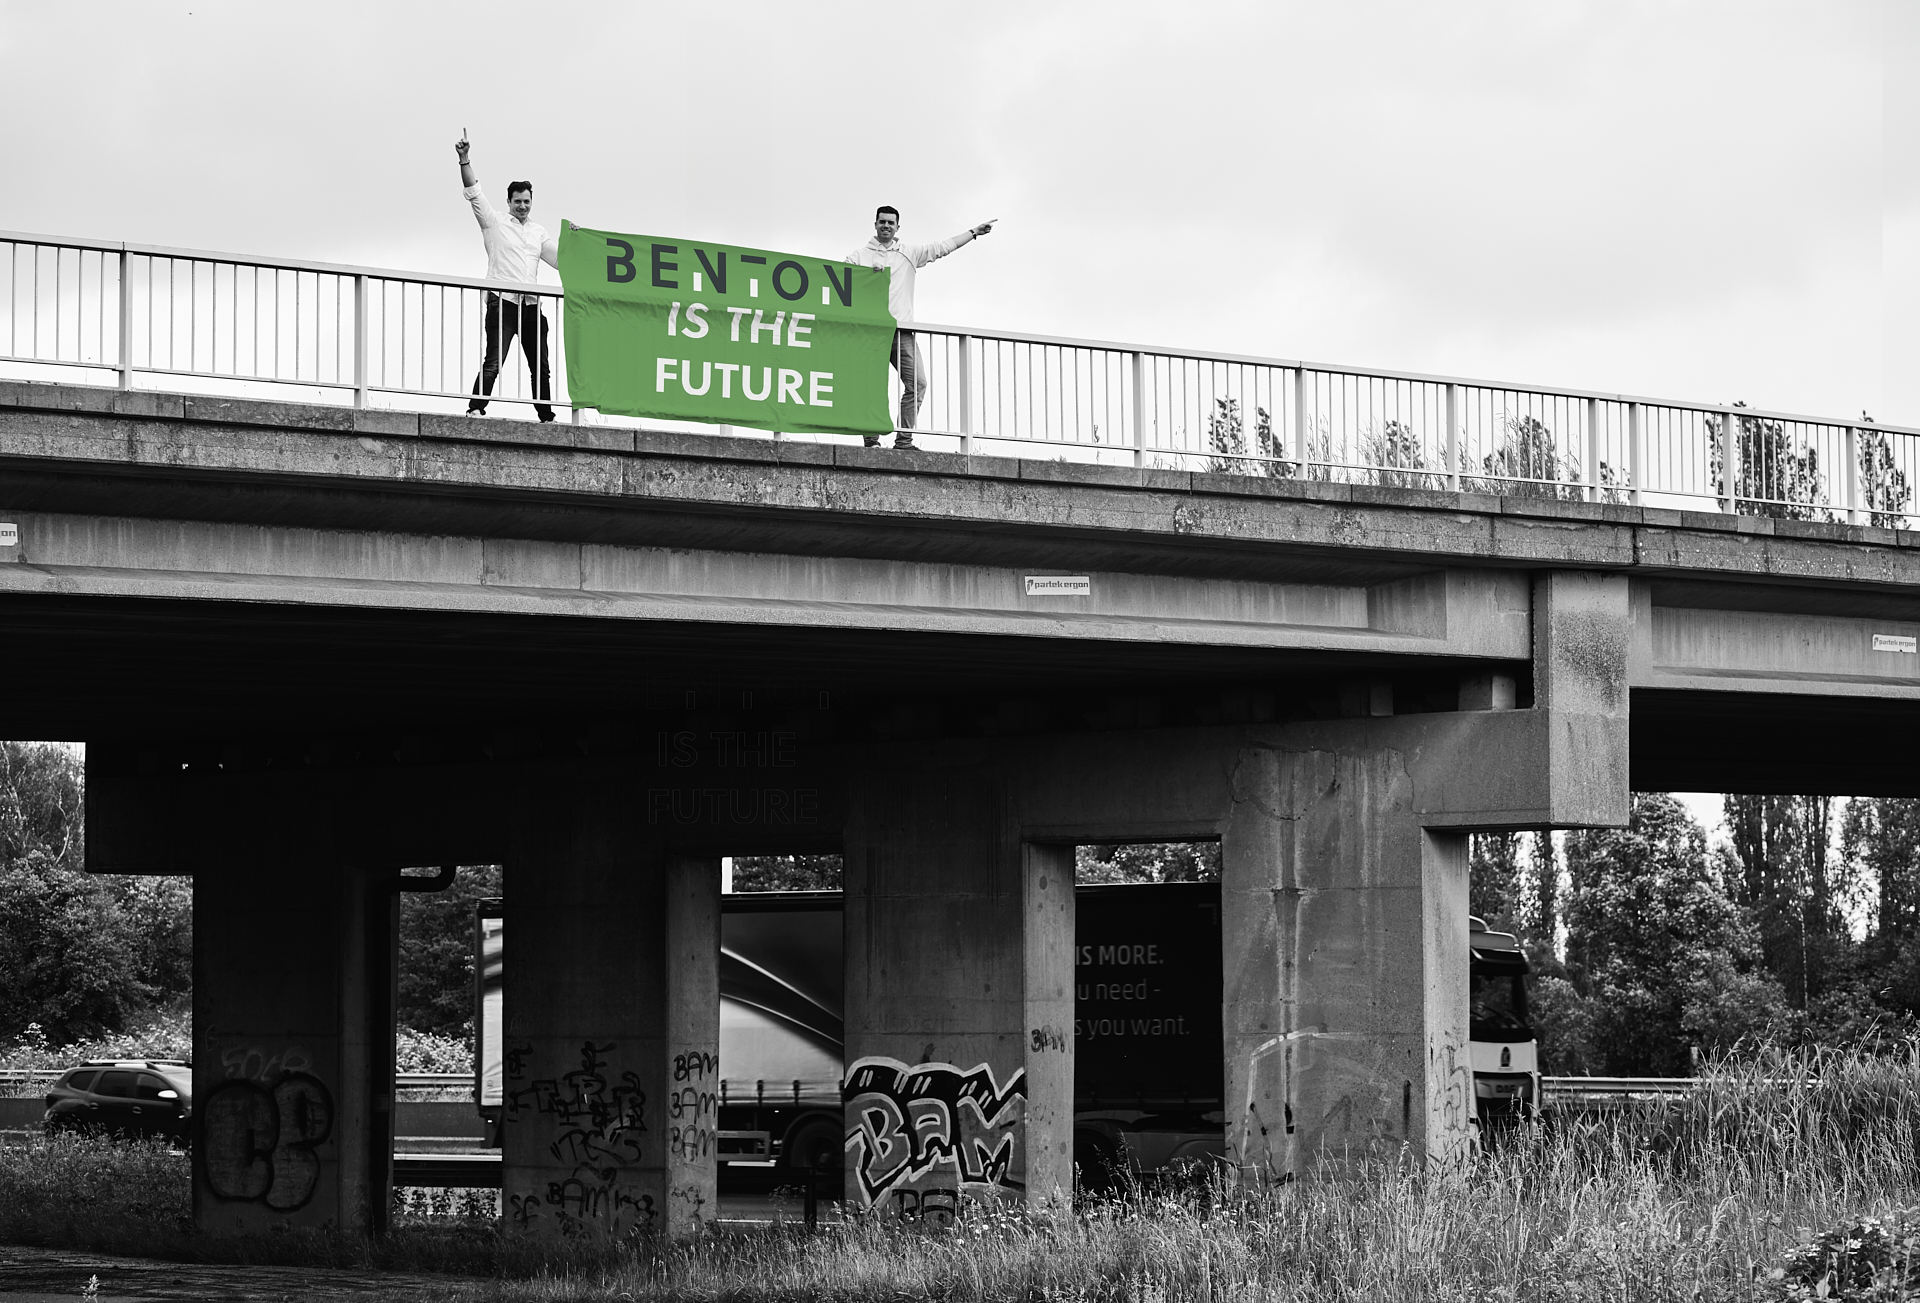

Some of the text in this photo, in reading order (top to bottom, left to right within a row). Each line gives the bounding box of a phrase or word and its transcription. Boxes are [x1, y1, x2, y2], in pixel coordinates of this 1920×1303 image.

[606, 238, 853, 307] BENTON
[668, 302, 816, 348] IS THE
[656, 357, 834, 407] FUTURE
[1075, 944, 1164, 966] IS MORE.
[1096, 978, 1147, 1000] need
[1087, 1019, 1125, 1041] you
[1130, 1015, 1190, 1036] want.
[673, 1052, 718, 1081] BAM
